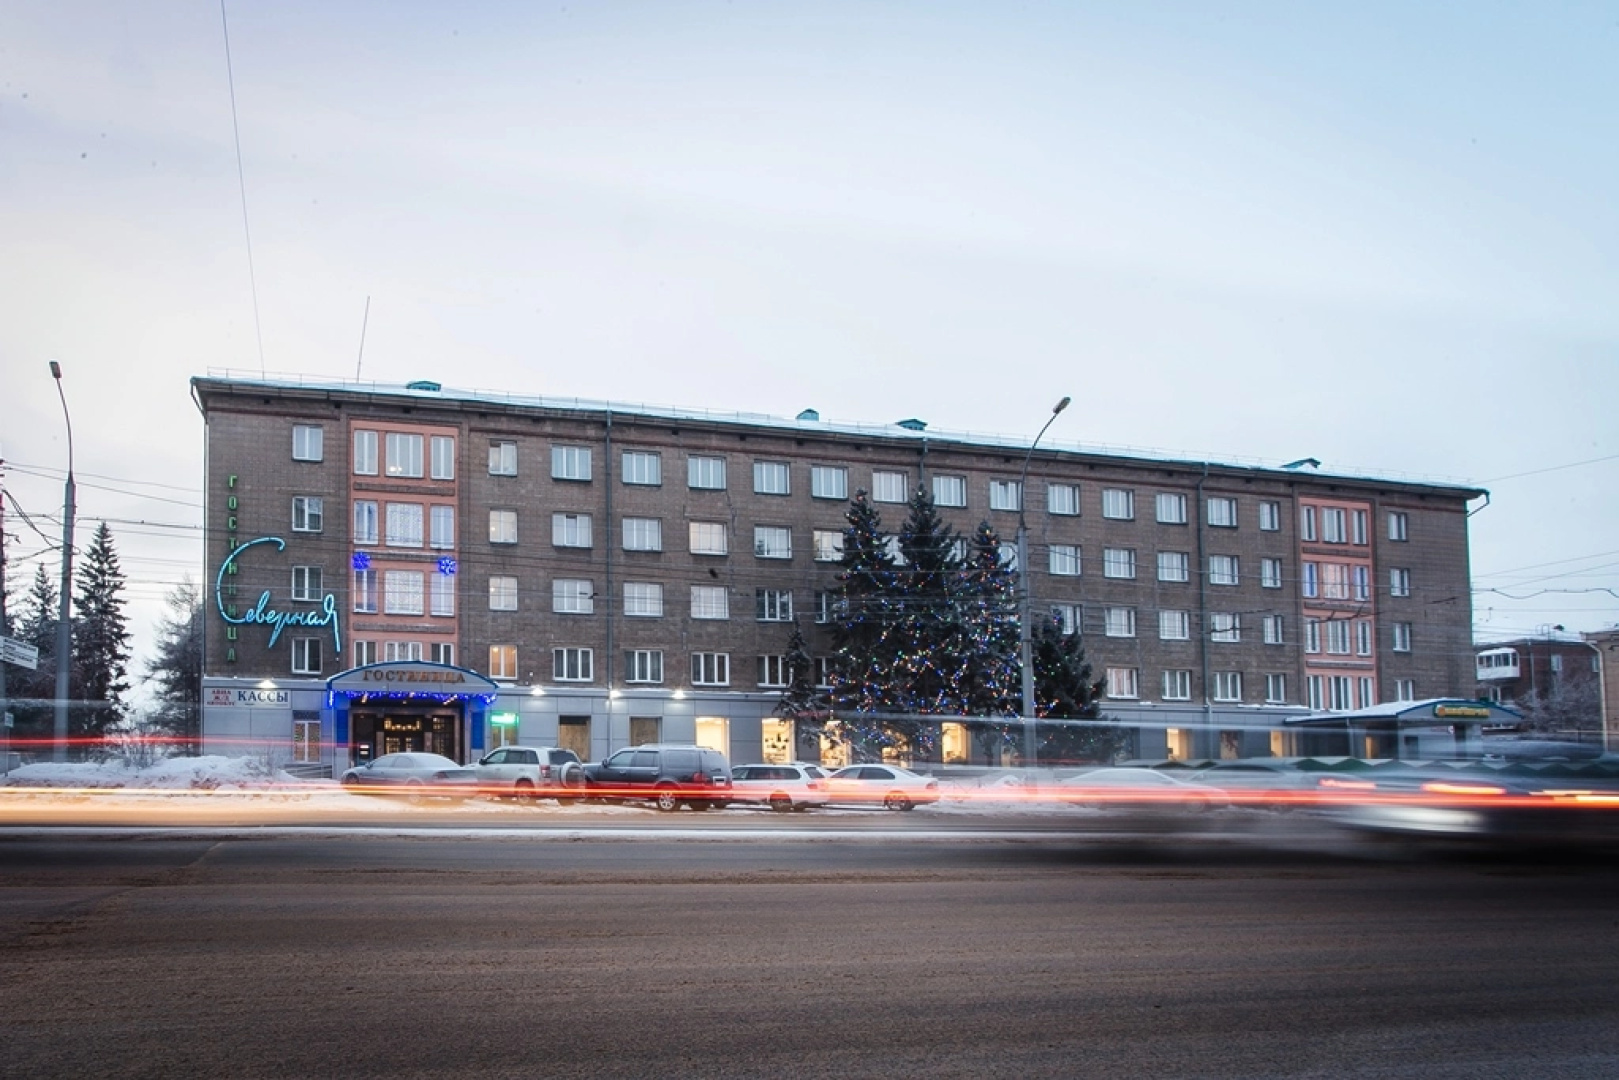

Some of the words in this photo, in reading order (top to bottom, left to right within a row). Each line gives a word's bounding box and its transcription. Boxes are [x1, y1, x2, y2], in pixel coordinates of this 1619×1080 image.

[216, 536, 341, 653] Северная
[227, 475, 238, 662] ГОСТИНИЦА
[237, 690, 289, 703] КАССЫ
